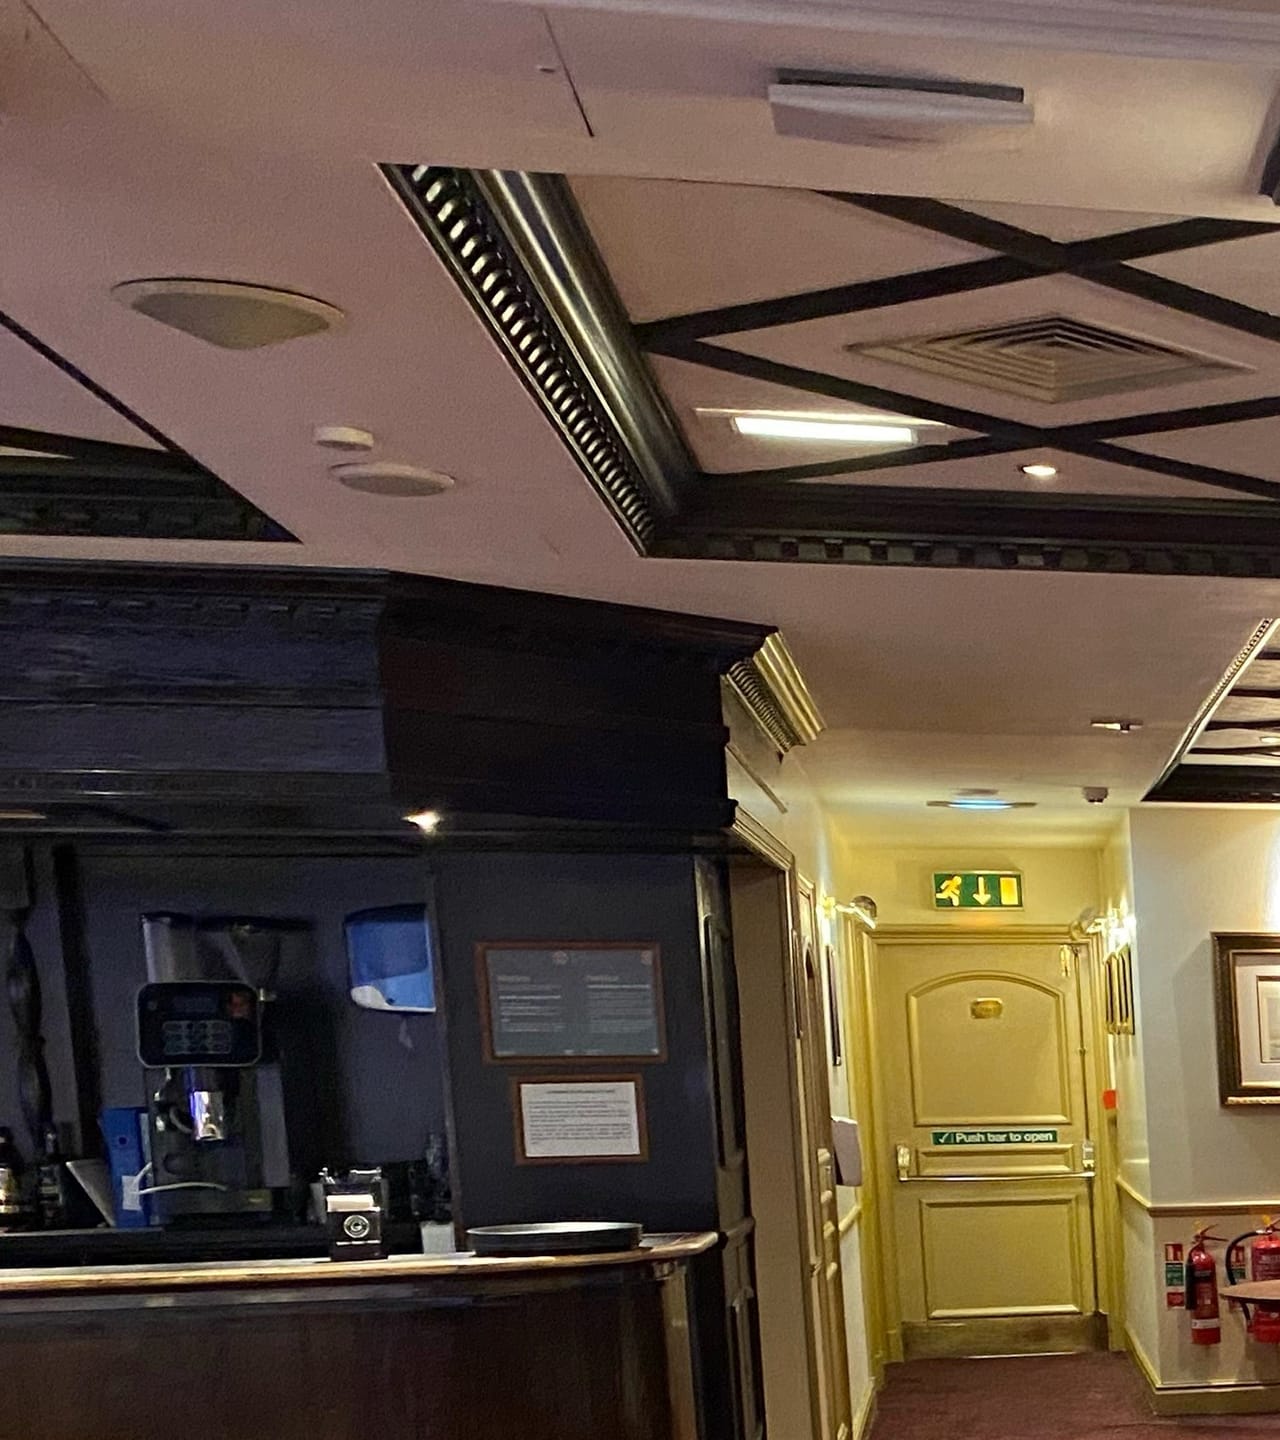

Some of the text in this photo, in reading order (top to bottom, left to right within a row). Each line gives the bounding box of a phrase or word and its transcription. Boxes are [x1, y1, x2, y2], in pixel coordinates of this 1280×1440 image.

[955, 1132, 1053, 1143] Push bar to open
